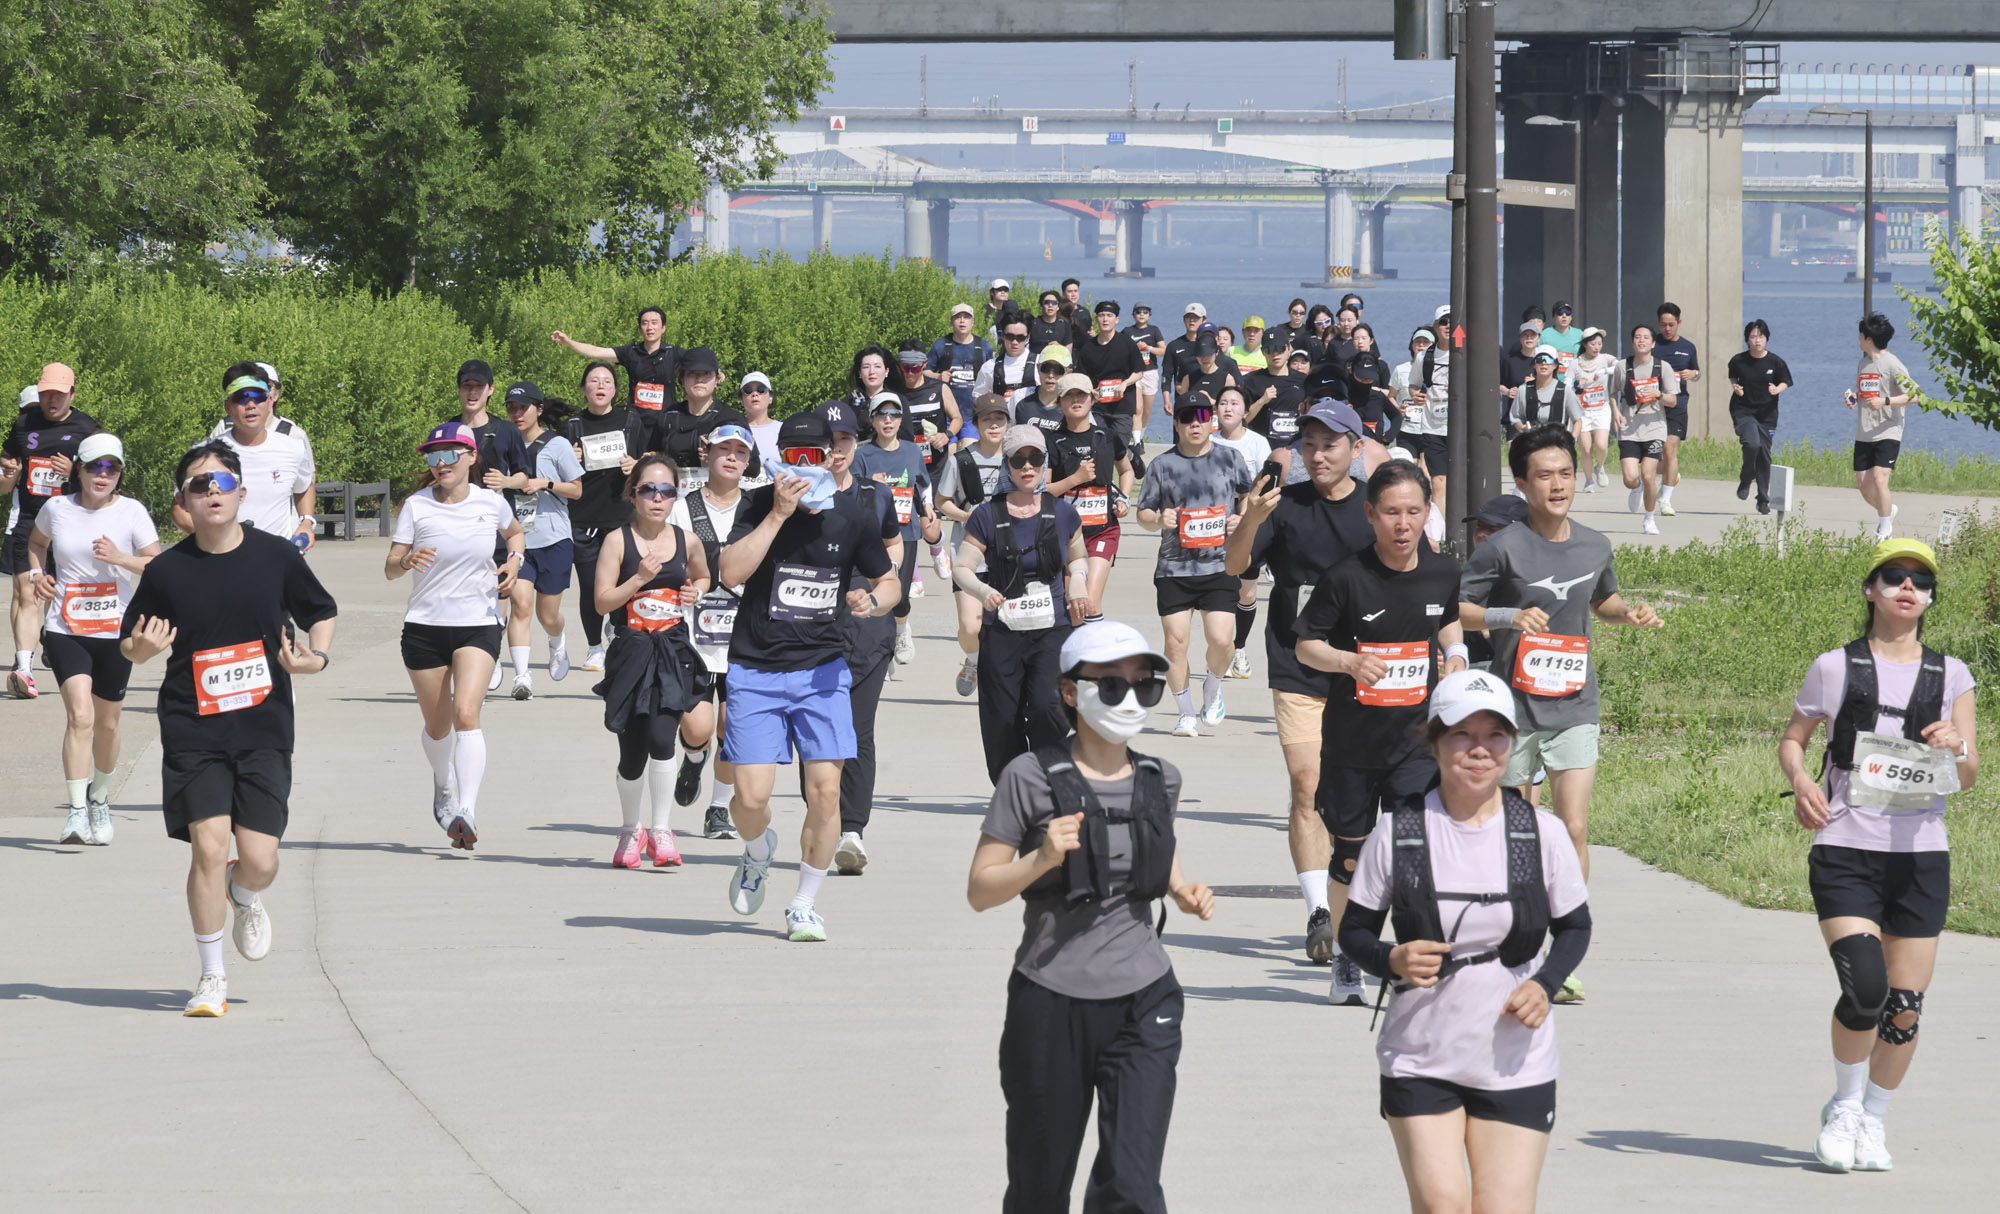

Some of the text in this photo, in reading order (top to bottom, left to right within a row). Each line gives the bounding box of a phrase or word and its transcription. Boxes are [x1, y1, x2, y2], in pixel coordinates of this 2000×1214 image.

[26, 432, 39, 450] S
[599, 443, 624, 454] 5838
[43, 471, 68, 482] 1972
[1080, 499, 1106, 509] 4579
[1199, 519, 1224, 531] 1668
[785, 587, 838, 599] M 7017
[72, 600, 117, 611] W 3834
[1008, 597, 1051, 610] W 5985
[1530, 656, 1584, 671] M 1192
[208, 663, 265, 685] M 1975
[1388, 664, 1425, 678] 1191
[1465, 686, 1494, 694] adidas
[222, 695, 248, 707] B-333
[1894, 742, 1911, 751] RUN
[1868, 762, 1934, 784] W 5961
